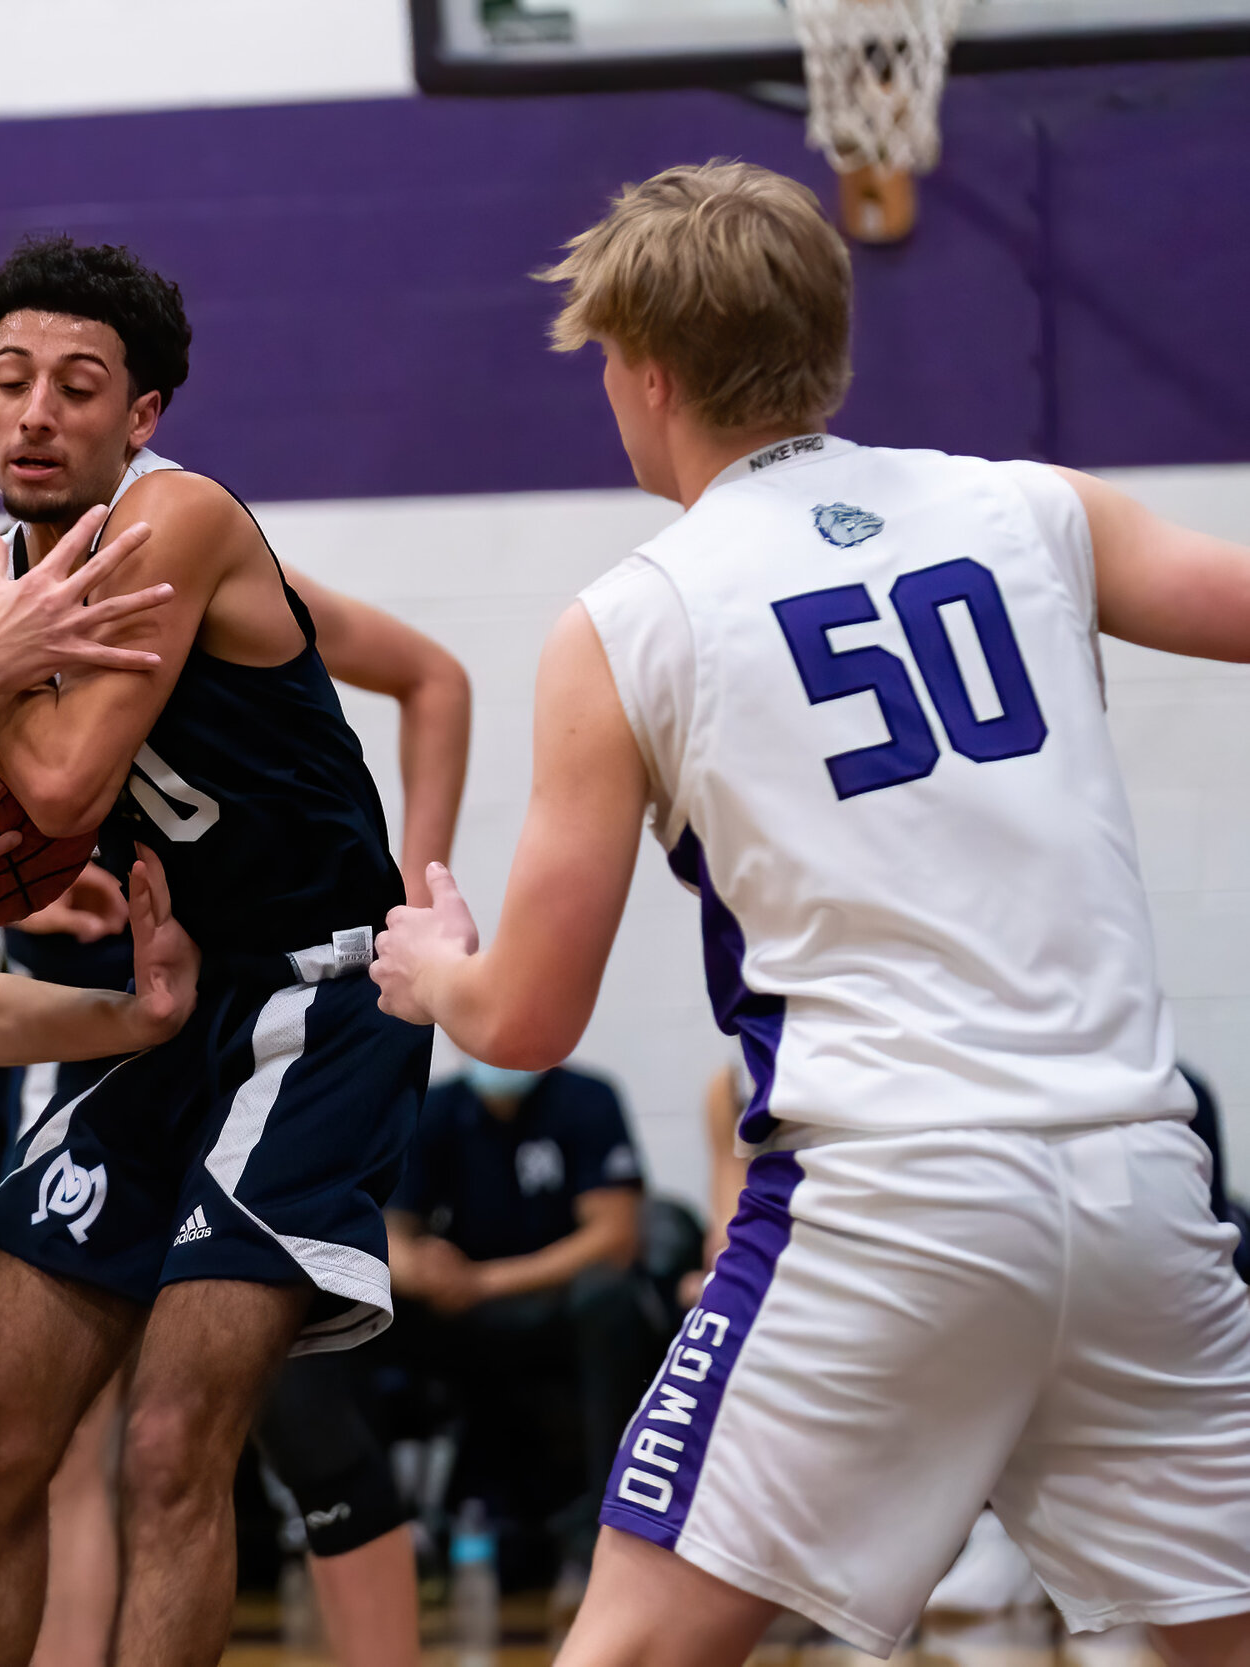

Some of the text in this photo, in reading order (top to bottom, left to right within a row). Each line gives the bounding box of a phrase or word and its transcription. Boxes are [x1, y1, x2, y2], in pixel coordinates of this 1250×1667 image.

[749, 435, 824, 472] NIKE PRO
[770, 556, 1049, 801] 50
[173, 1225, 212, 1247] adidas
[617, 1308, 730, 1514] DAWGS
